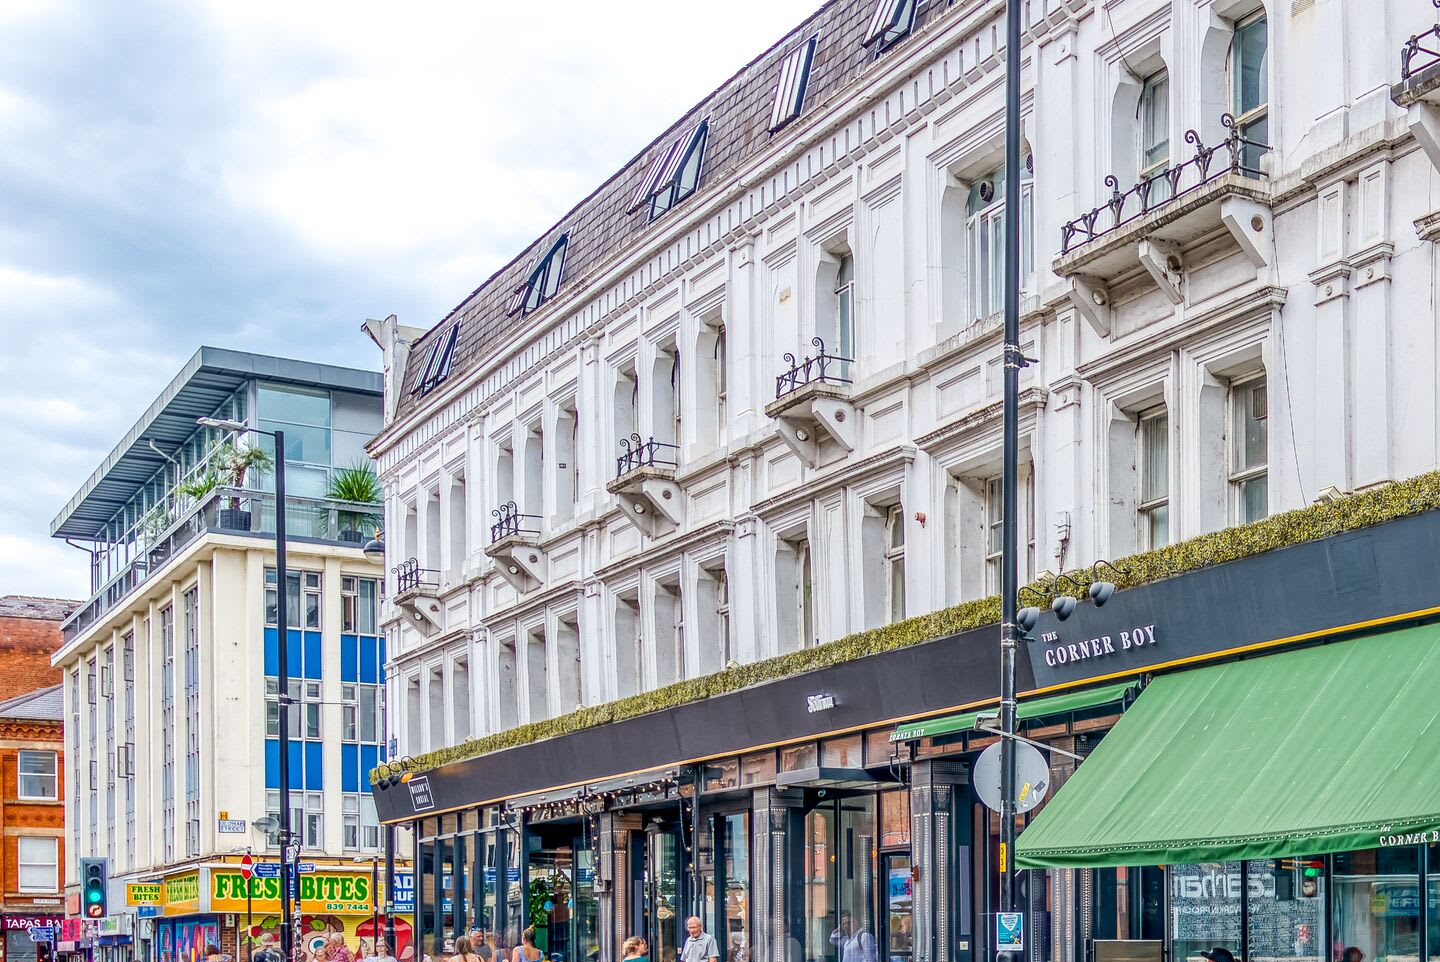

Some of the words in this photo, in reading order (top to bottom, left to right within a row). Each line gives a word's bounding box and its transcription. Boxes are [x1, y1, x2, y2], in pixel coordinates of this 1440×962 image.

[1041, 631, 1058, 642] THE
[1045, 636, 1115, 667] CORNER
[1120, 625, 1156, 650] BOY
[1380, 832, 1427, 847] CORNER
[215, 875, 284, 899] FRES
[300, 876, 368, 901] BITES
[133, 893, 159, 901] BITES
[6, 919, 40, 928] TAPAS
[46, 919, 63, 928] BA
